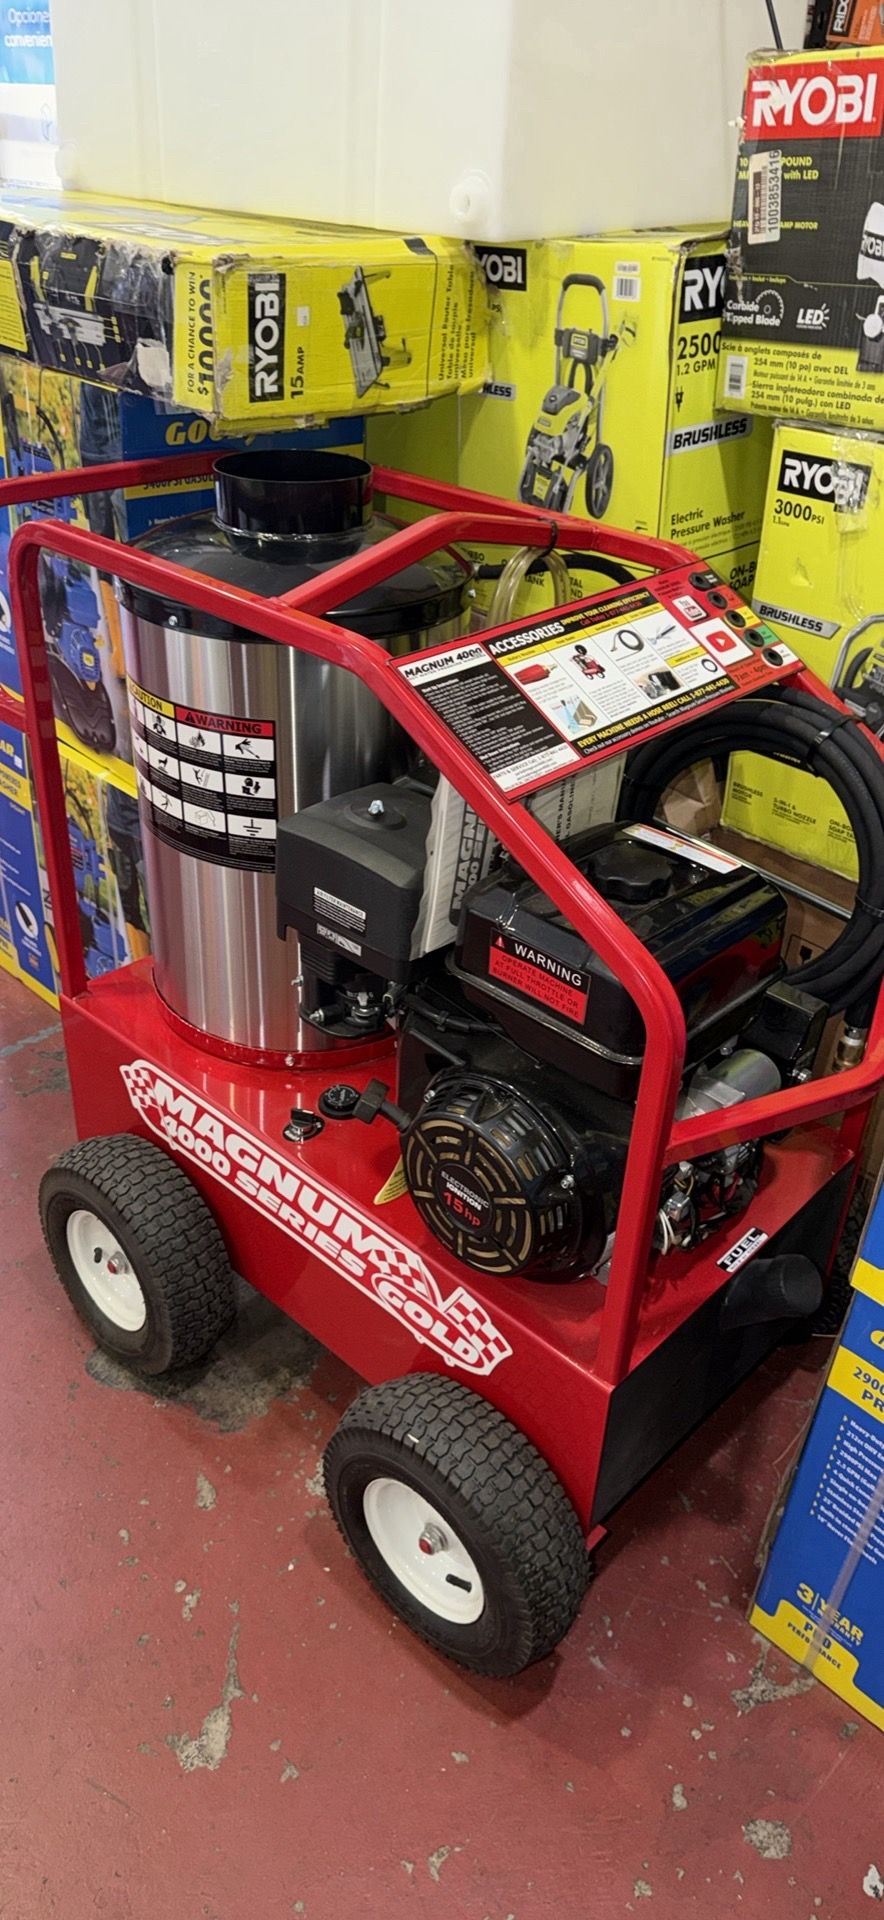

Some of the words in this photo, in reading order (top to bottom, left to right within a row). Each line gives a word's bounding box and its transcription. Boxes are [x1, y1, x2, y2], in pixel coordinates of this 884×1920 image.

[8, 8, 50, 28] Opcione
[4, 35, 52, 47] convenien
[751, 73, 877, 126] RYOBI
[781, 156, 812, 167] POUND
[803, 170, 819, 180] LED
[768, 150, 780, 233] 1003853416
[780, 222, 793, 230] AMP
[188, 271, 196, 295] WIN
[683, 266, 726, 312] RY
[188, 299, 196, 313] TO
[726, 299, 760, 313] Carbide
[796, 308, 824, 326] LED
[755, 314, 781, 327] Blade
[187, 318, 196, 360] CHANCE
[254, 281, 280, 397] RYOBI
[722, 341, 736, 352] Scie
[812, 351, 822, 360] de
[188, 362, 195, 371] A
[676, 362, 690, 377] 1.2
[693, 358, 716, 374] GPM
[753, 357, 768, 366] 254
[769, 360, 784, 368] mm
[813, 365, 832, 375] avec
[834, 365, 849, 375] DEL
[187, 373, 196, 393] FOR
[752, 381, 774, 391] Sierra
[827, 390, 873, 403] combinada
[751, 390, 765, 399] 254
[766, 393, 780, 401] mm
[819, 401, 833, 409] con
[836, 401, 851, 410] LED
[673, 417, 748, 450] BRUSHLESS
[671, 508, 704, 525] Electric
[671, 520, 711, 540] Pressure
[713, 510, 745, 528] Washer
[729, 561, 757, 580] ON-B
[758, 604, 824, 633] BRUSHLESS
[487, 621, 566, 657] ACCESSORIES
[404, 654, 455, 679] MAGNUM
[196, 713, 262, 735] WARNING
[577, 734, 598, 748] EVERY
[596, 722, 626, 740] MACHINE
[622, 714, 644, 728] NEEDS
[646, 706, 664, 718] HOSE
[828, 818, 852, 831] ON-BO
[502, 954, 537, 976] OPERATE
[540, 973, 574, 995] MACHINE
[514, 942, 583, 987] WARNING
[154, 1078, 384, 1260] MAGNUM
[160, 1115, 231, 1177] 4000
[234, 1170, 367, 1278] SERIES
[441, 1170, 490, 1209] ELECTRONIC
[446, 1181, 482, 1211] IGNITION
[724, 1234, 760, 1266] FUEL
[378, 1280, 481, 1365] GOLD
[861, 1389, 884, 1413] PR
[796, 1582, 815, 1605] 3
[787, 1622, 842, 1669] PERFOANCE
